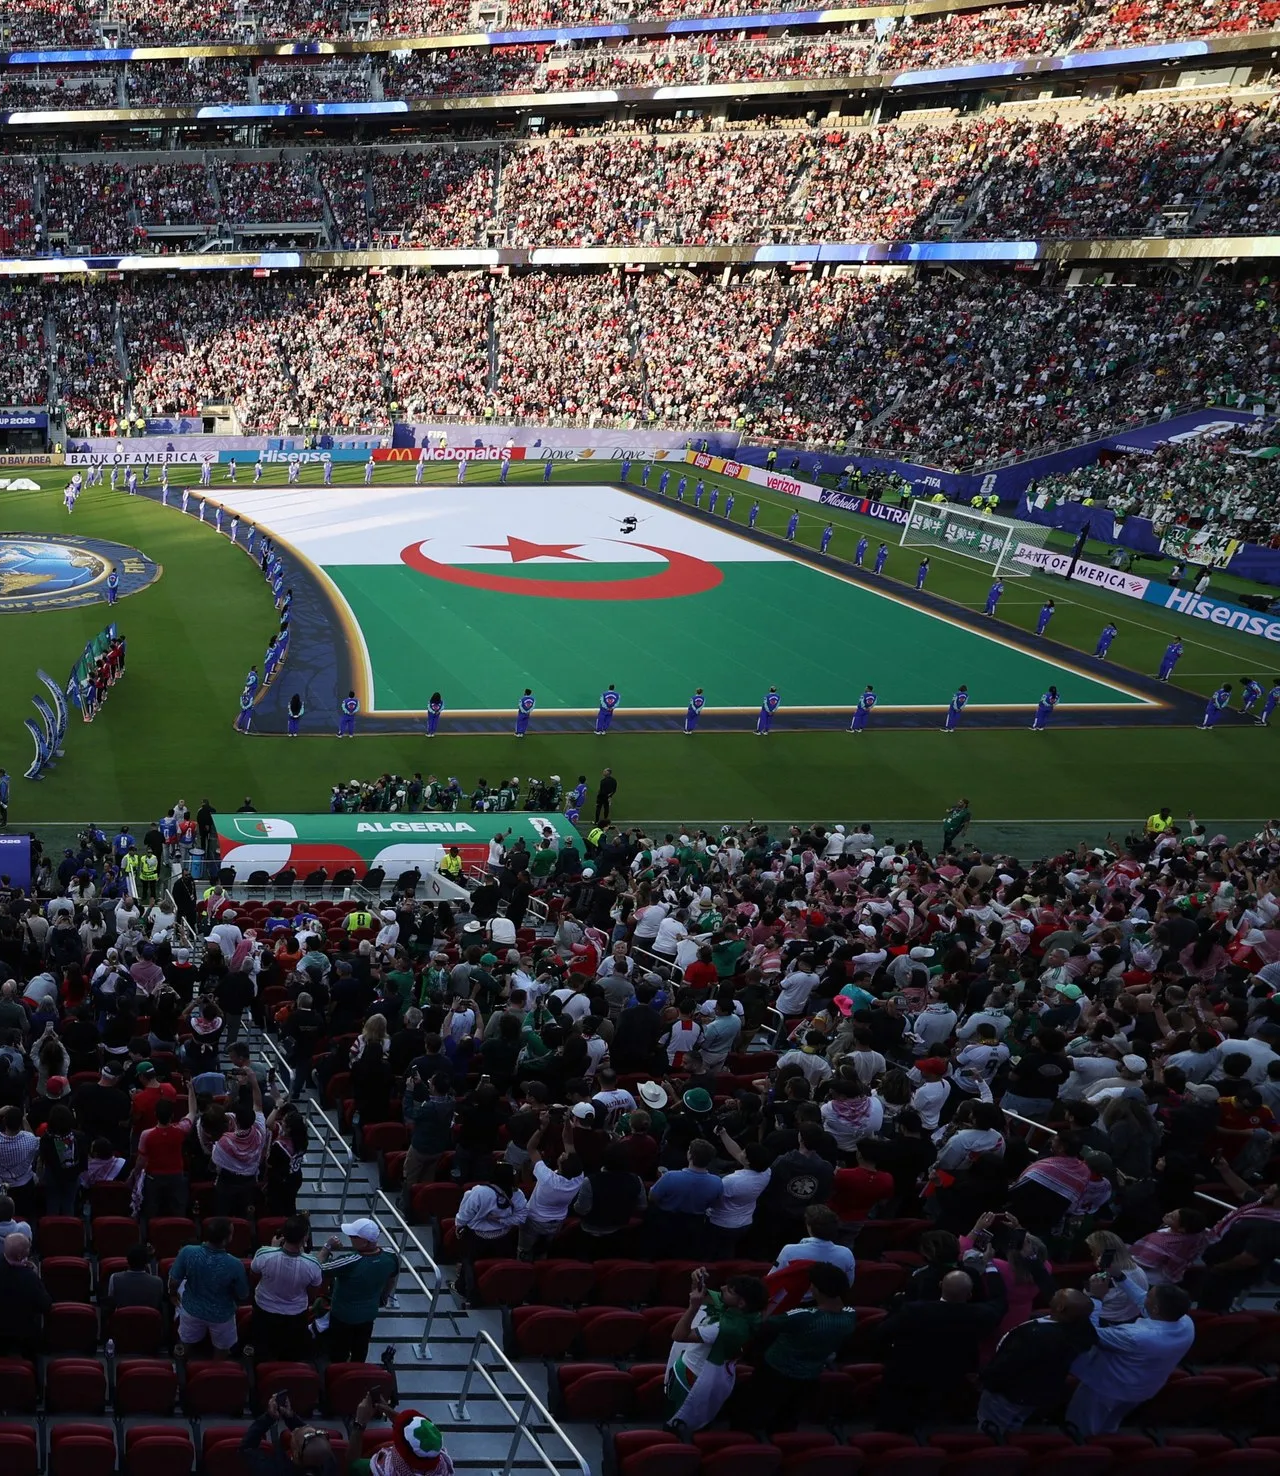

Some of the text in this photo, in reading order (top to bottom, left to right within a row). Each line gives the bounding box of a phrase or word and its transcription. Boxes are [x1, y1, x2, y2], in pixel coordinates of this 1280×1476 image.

[10, 417, 36, 425] 2026
[428, 430, 447, 439] FIFA
[7, 455, 25, 465] BAY
[26, 455, 51, 464] AREA
[71, 452, 198, 464] BANK OF AMERICA
[258, 450, 331, 463] Hisense
[419, 447, 512, 461] McDonald's
[540, 447, 573, 460] Dove
[610, 447, 646, 460] Dove
[694, 454, 711, 468] Lay's
[723, 463, 740, 476] Lay's
[767, 475, 801, 496] verizon
[924, 475, 941, 489] FIFA
[820, 489, 908, 525] Michelob ULTRA
[1019, 548, 1126, 589] BANK OF MERICA
[33, 592, 100, 607] 2026
[1164, 588, 1280, 642] Hisense
[356, 822, 477, 833] ALGERIA
